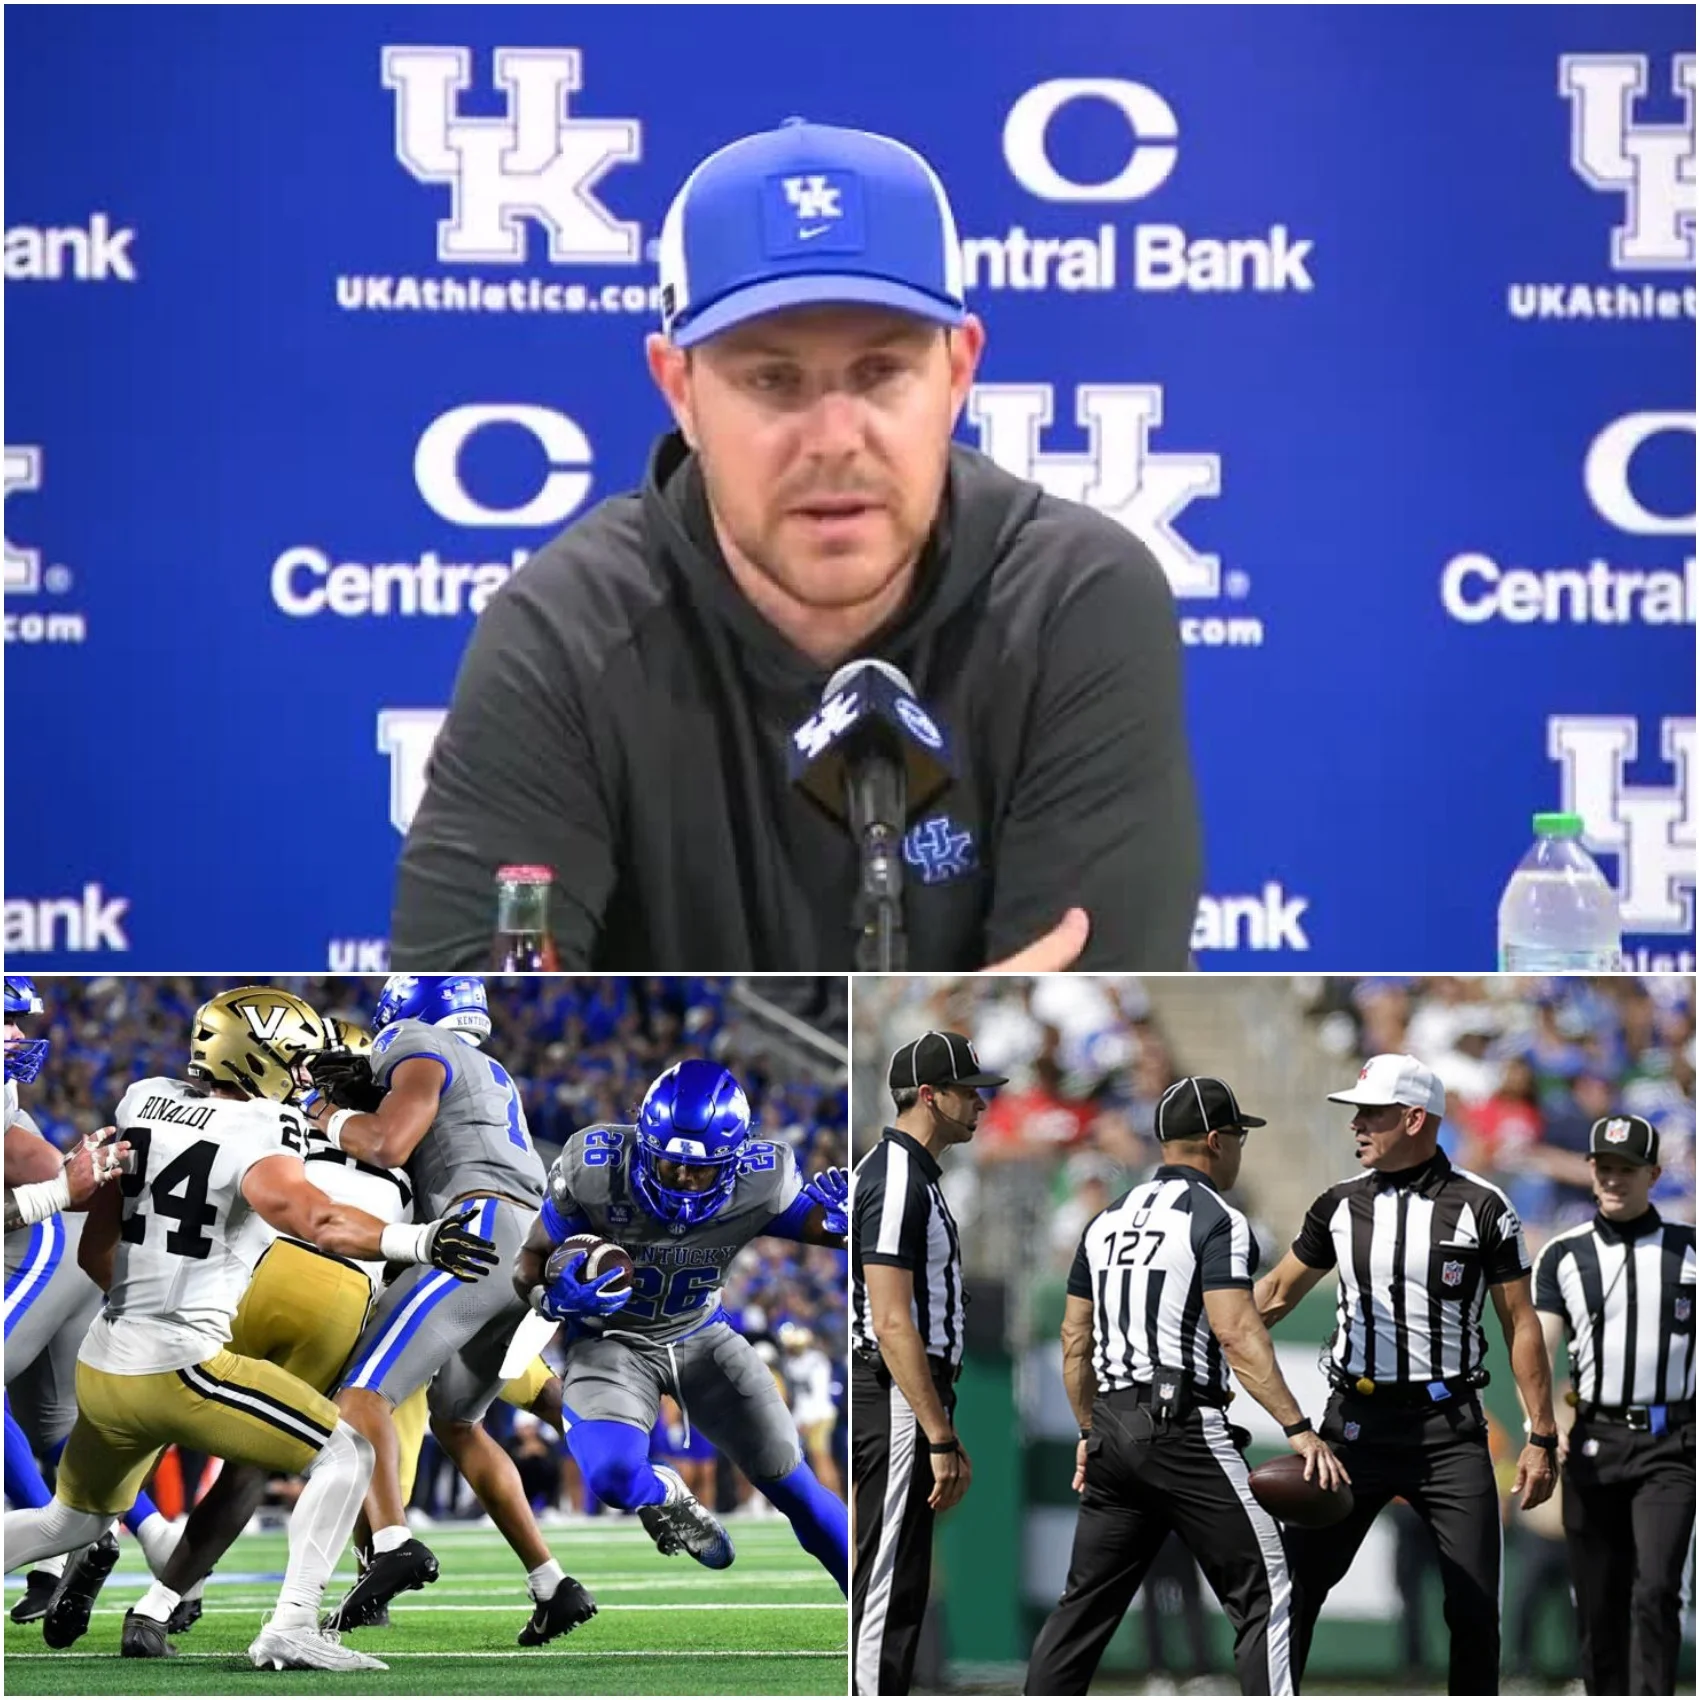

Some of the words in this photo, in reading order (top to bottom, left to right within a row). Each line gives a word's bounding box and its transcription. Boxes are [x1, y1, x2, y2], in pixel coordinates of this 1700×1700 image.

[783, 176, 842, 218] UK
[4, 211, 137, 282] ank
[962, 222, 1115, 291] ntral
[1134, 222, 1315, 291] Bank
[270, 547, 531, 617] Centra
[4, 614, 86, 643] com
[1180, 616, 1264, 647] com
[4, 884, 129, 953] ank
[1189, 880, 1310, 951] ank
[137, 1096, 216, 1131] RINALDI
[486, 1057, 531, 1153] 7
[583, 1129, 625, 1167] 26
[1132, 1210, 1151, 1229] U
[634, 1245, 736, 1267] NTUCKY
[1103, 1230, 1166, 1267] 127
[622, 1265, 721, 1320] 26
